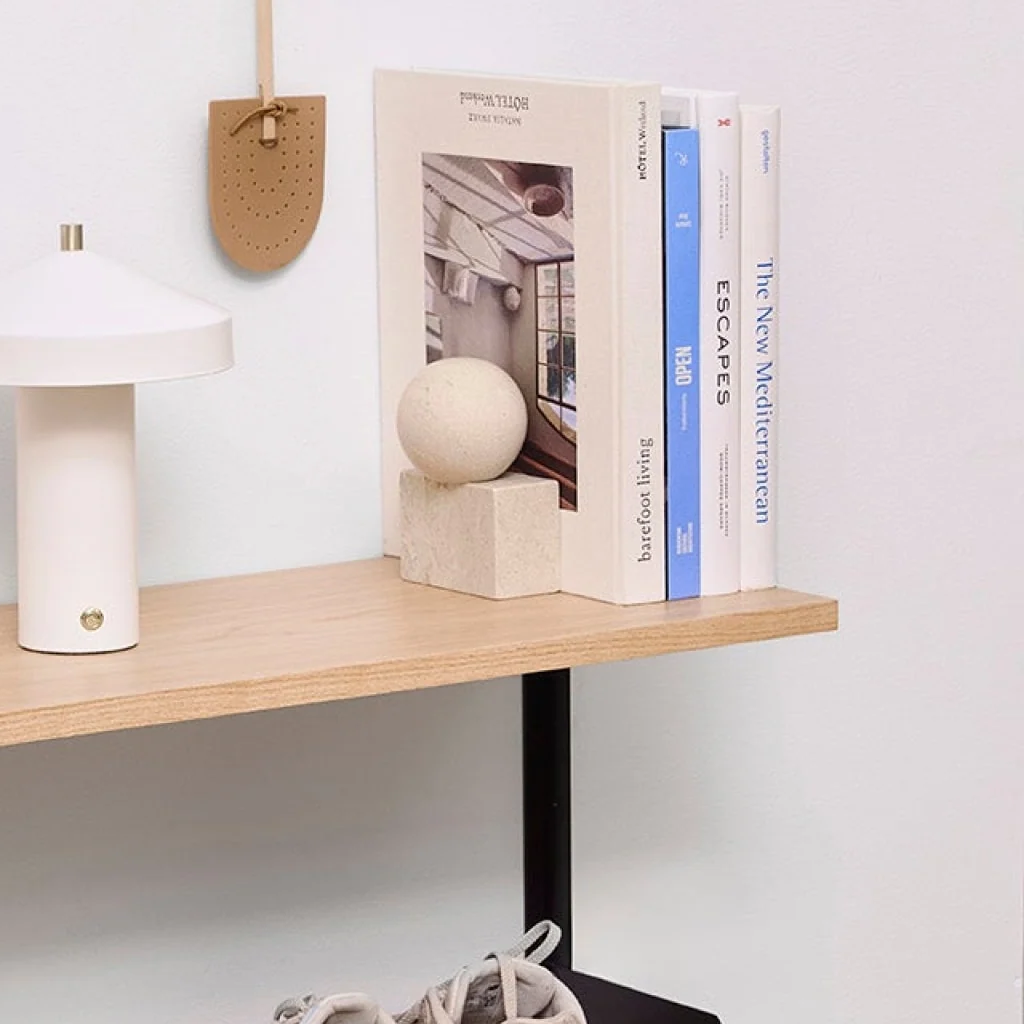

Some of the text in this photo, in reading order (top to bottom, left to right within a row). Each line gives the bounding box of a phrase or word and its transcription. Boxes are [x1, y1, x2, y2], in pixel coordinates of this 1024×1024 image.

[674, 345, 693, 386] OPEN
[716, 279, 731, 406] ESCAPES
[755, 256, 774, 524] The New Mediterranean
[636, 437, 654, 563] barefoot living
